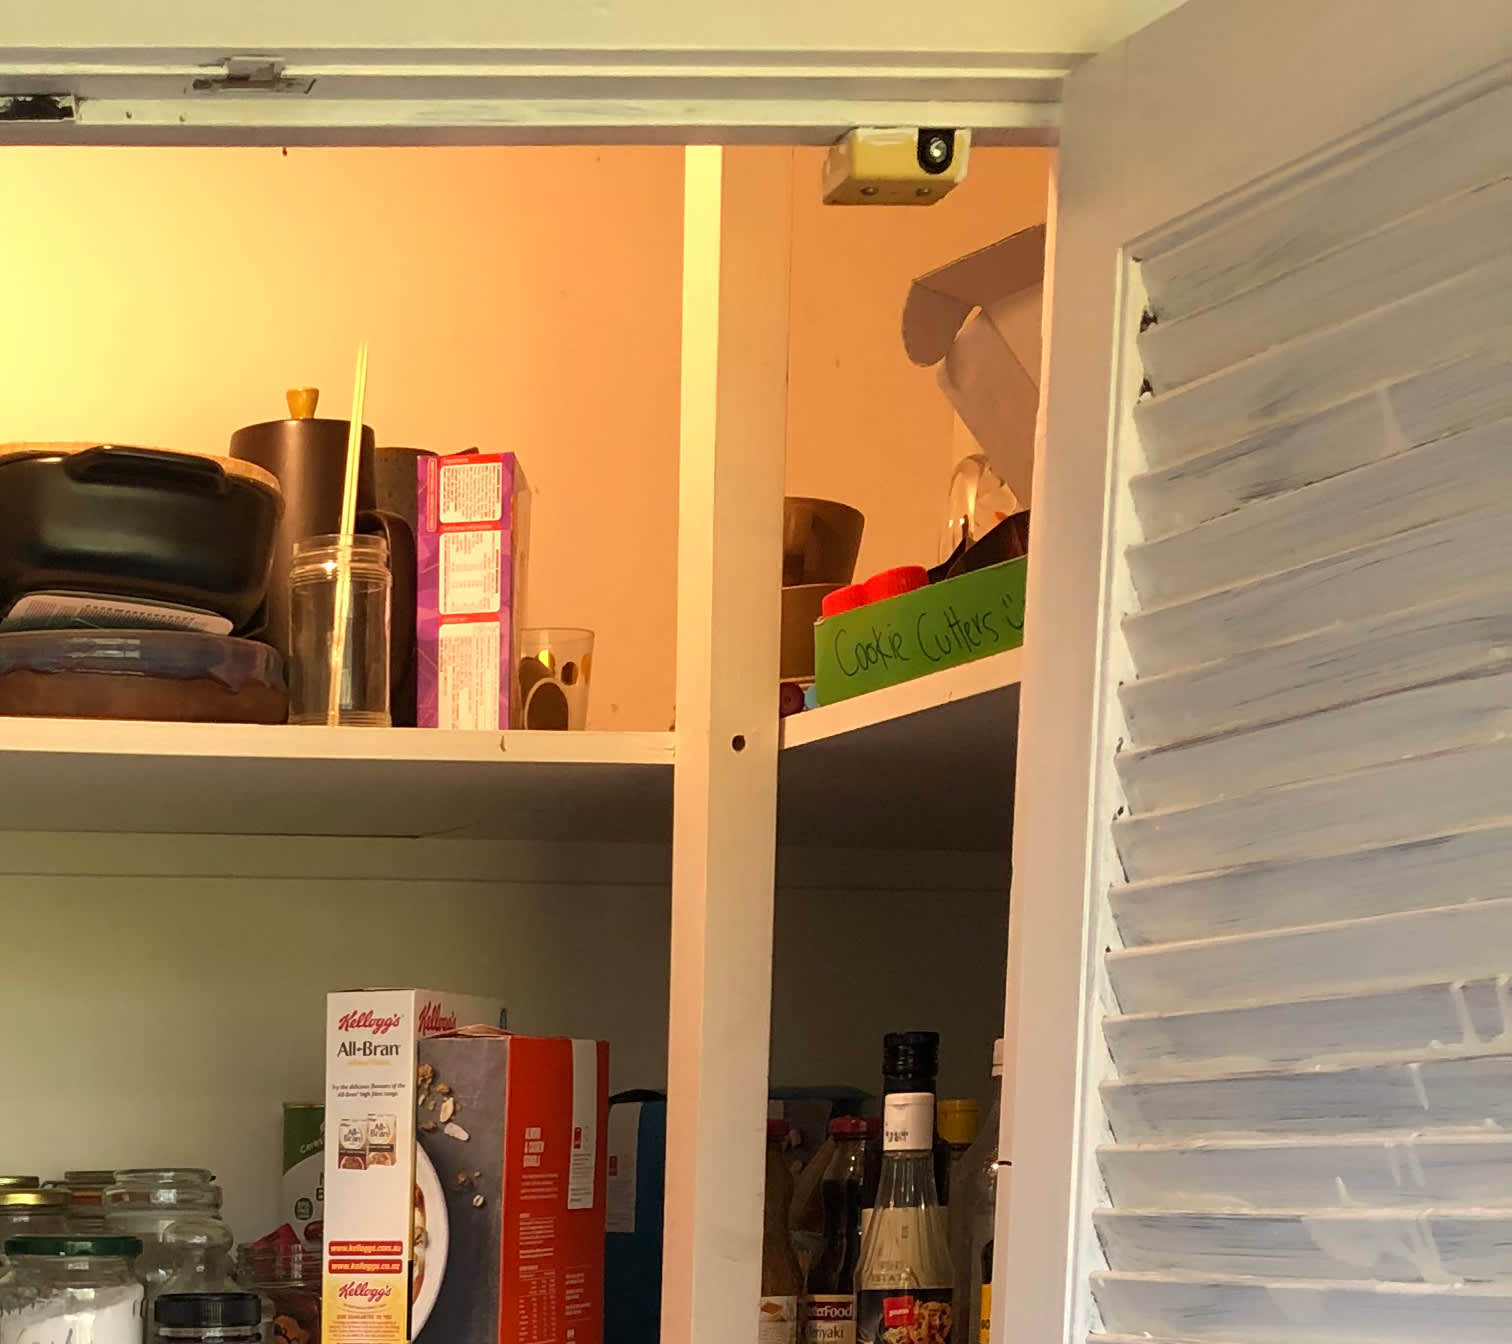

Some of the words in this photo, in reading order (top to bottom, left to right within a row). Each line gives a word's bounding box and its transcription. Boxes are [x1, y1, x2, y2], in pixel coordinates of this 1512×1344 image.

[834, 624, 909, 677] Cookie
[917, 607, 999, 662] Cutters
[338, 1010, 401, 1035] Kellogg's
[337, 1041, 401, 1057] All-Bran
[338, 1281, 392, 1302] Kellogg's
